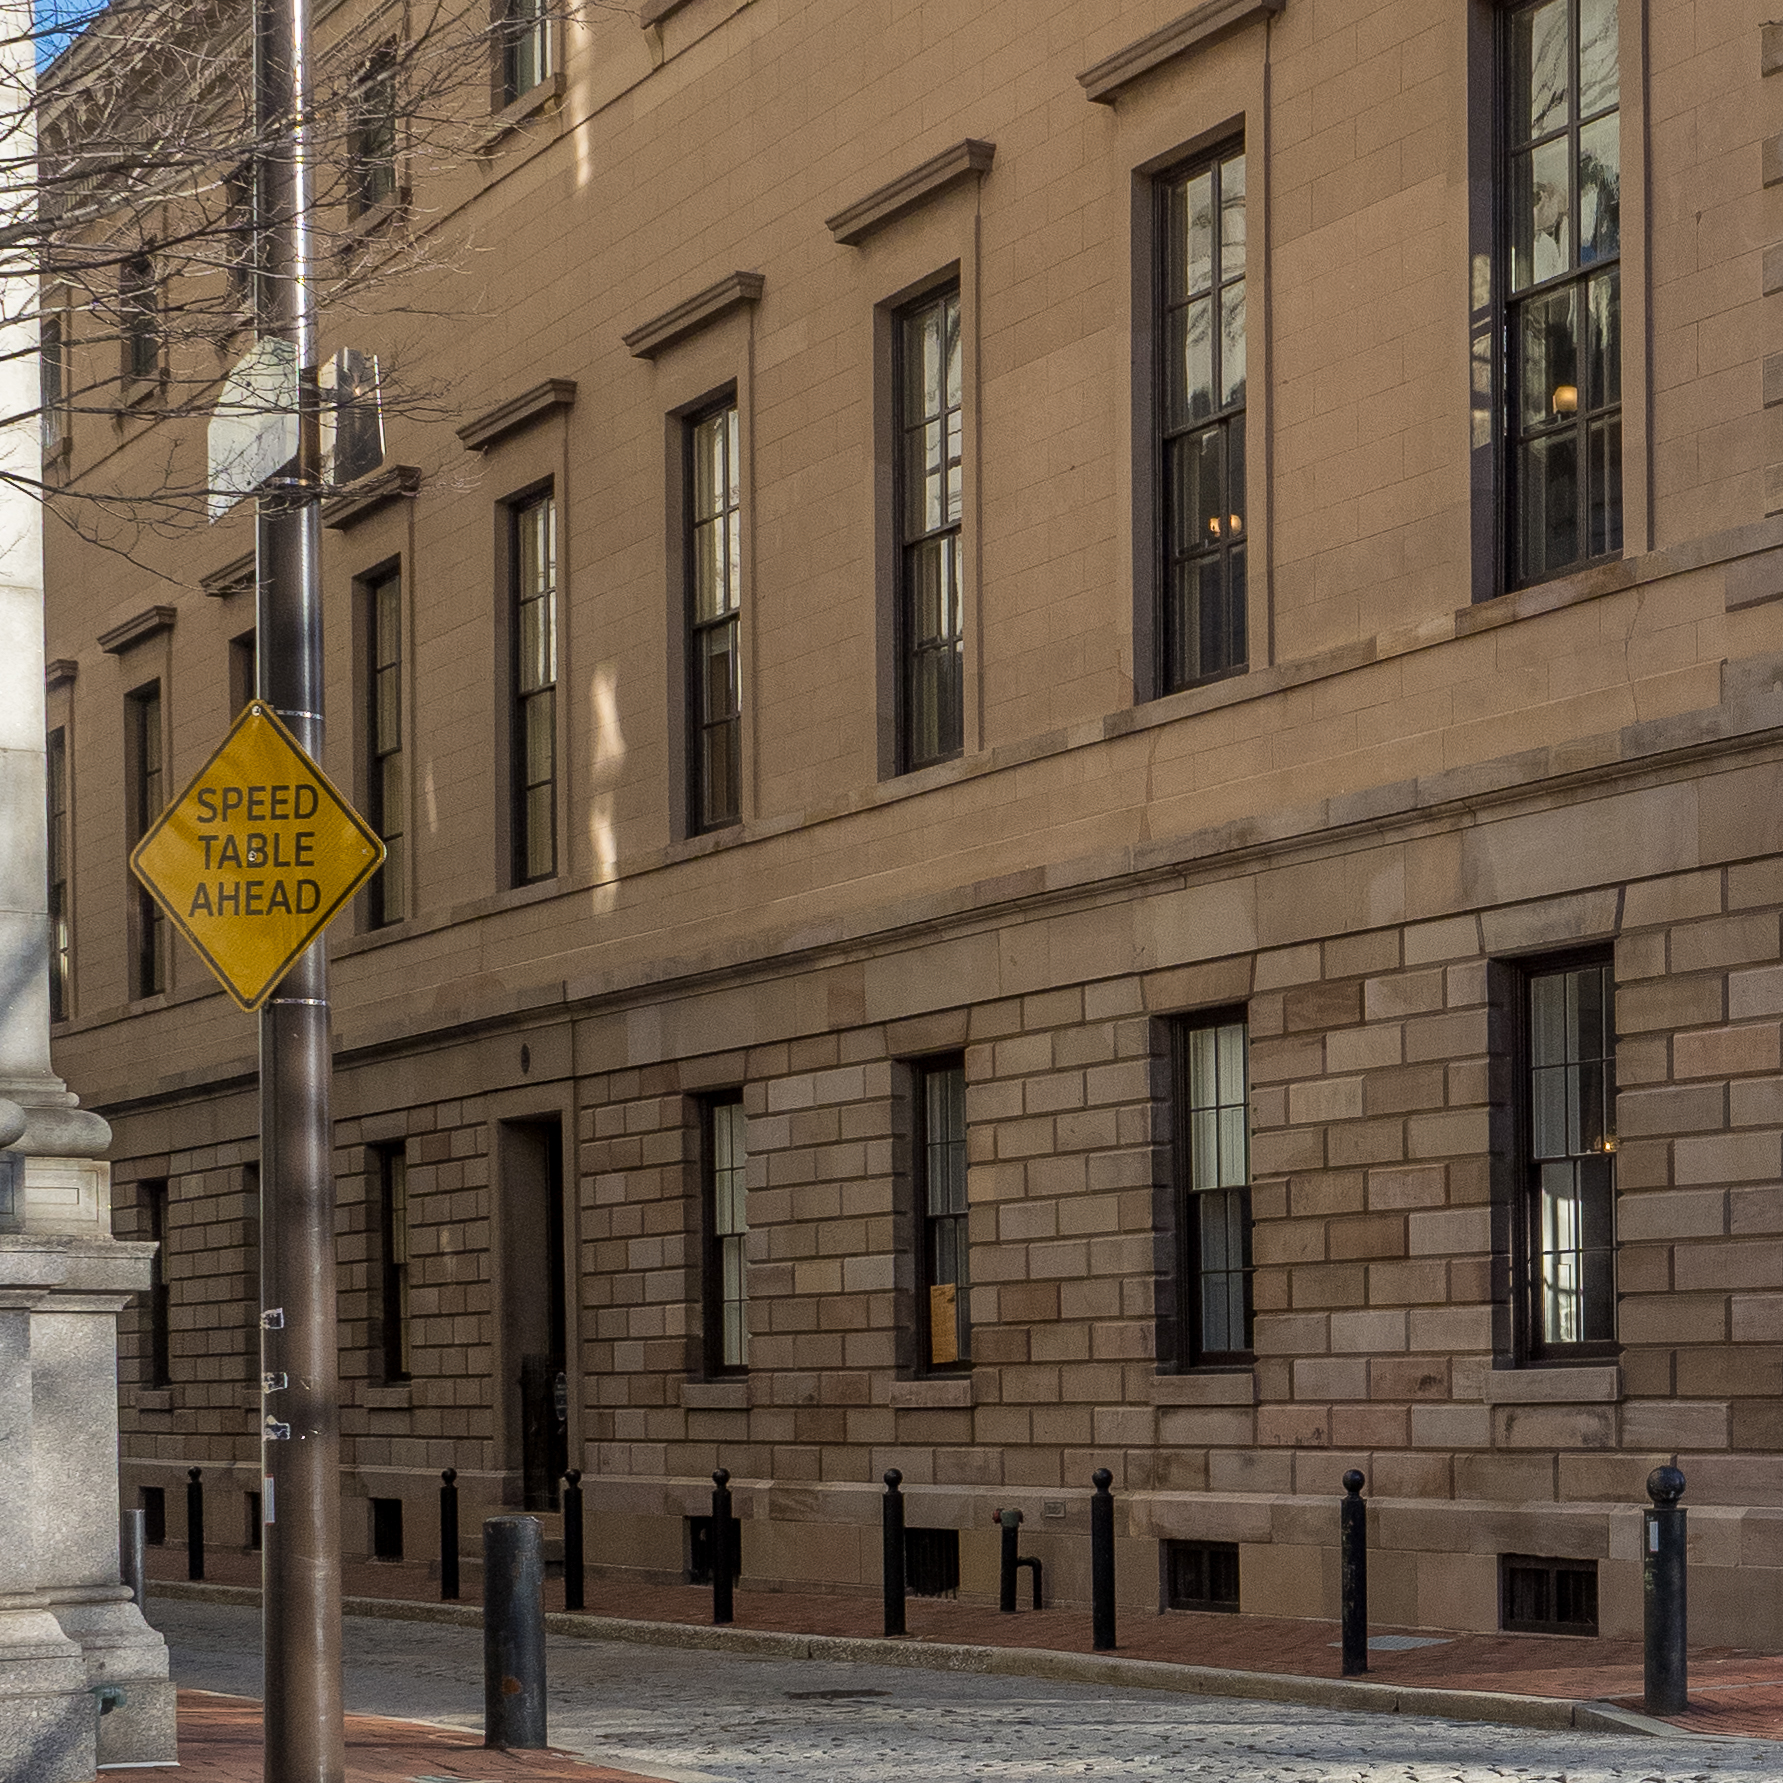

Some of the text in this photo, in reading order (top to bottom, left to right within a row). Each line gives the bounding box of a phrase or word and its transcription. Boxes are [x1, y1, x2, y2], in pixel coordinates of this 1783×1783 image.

[196, 784, 319, 823] SPEED
[197, 831, 316, 870] TABLE
[187, 879, 322, 918] AHEAD
